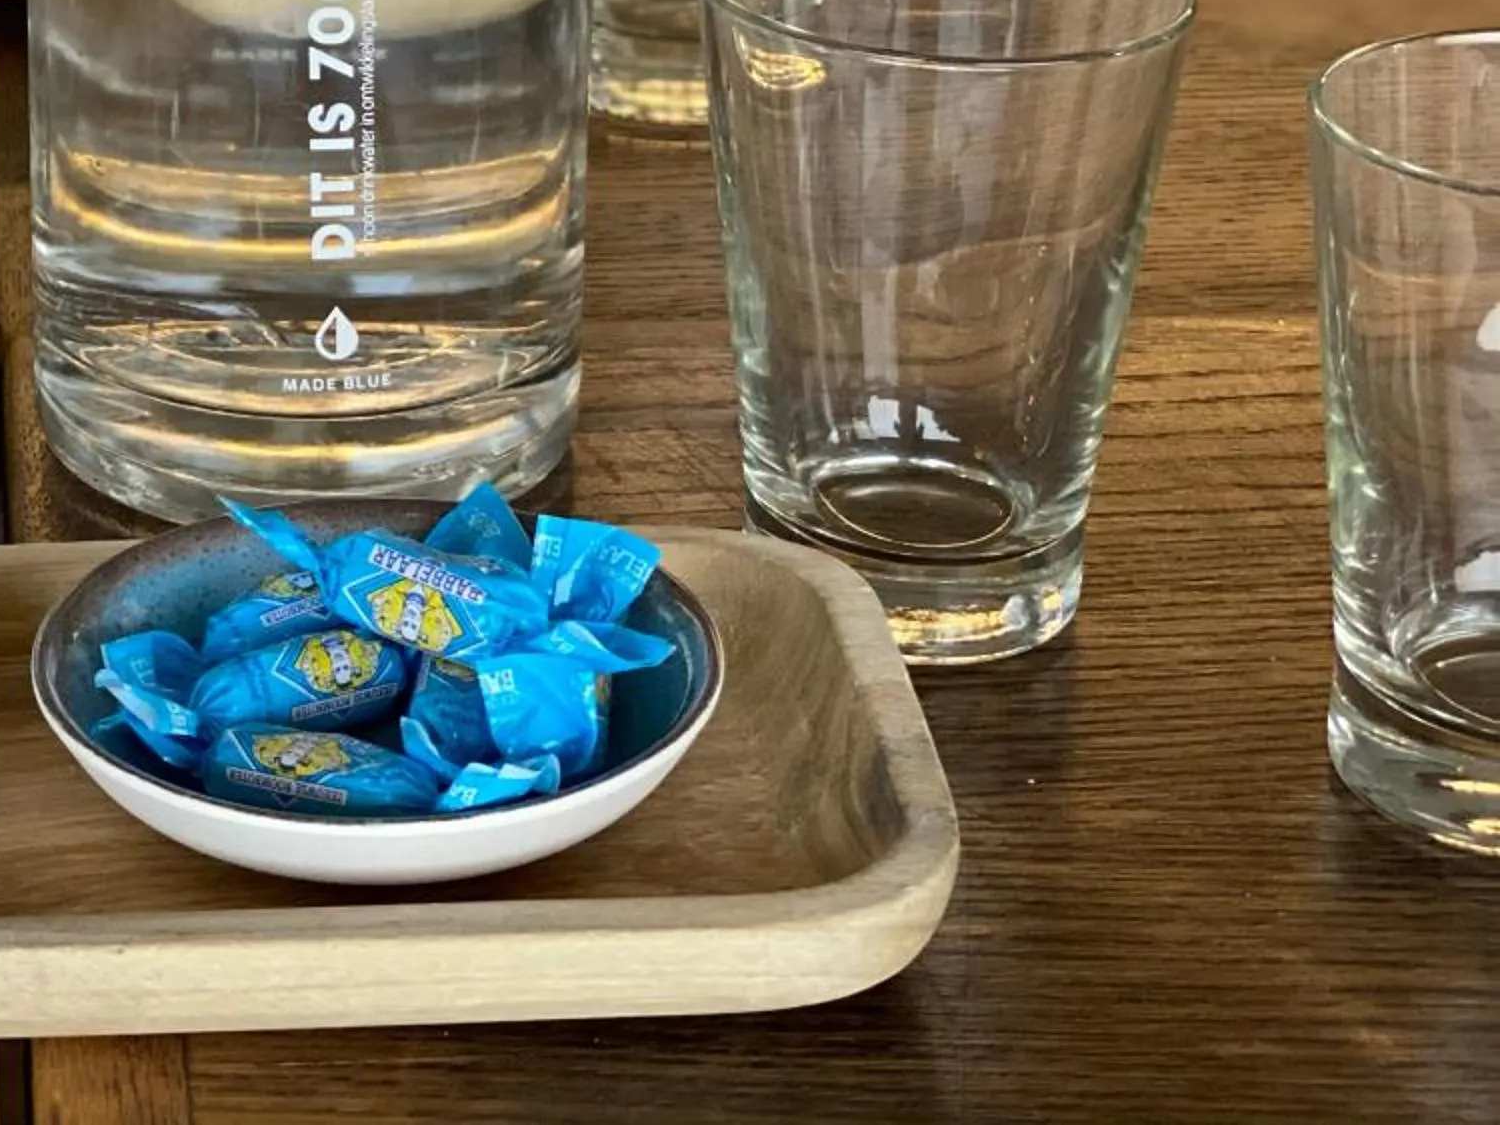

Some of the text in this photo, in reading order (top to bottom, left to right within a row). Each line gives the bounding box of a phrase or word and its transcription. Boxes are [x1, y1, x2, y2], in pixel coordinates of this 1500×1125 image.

[308, 102, 356, 151] IS
[310, 171, 356, 261] DIT
[282, 372, 393, 393] MADE BLUE
